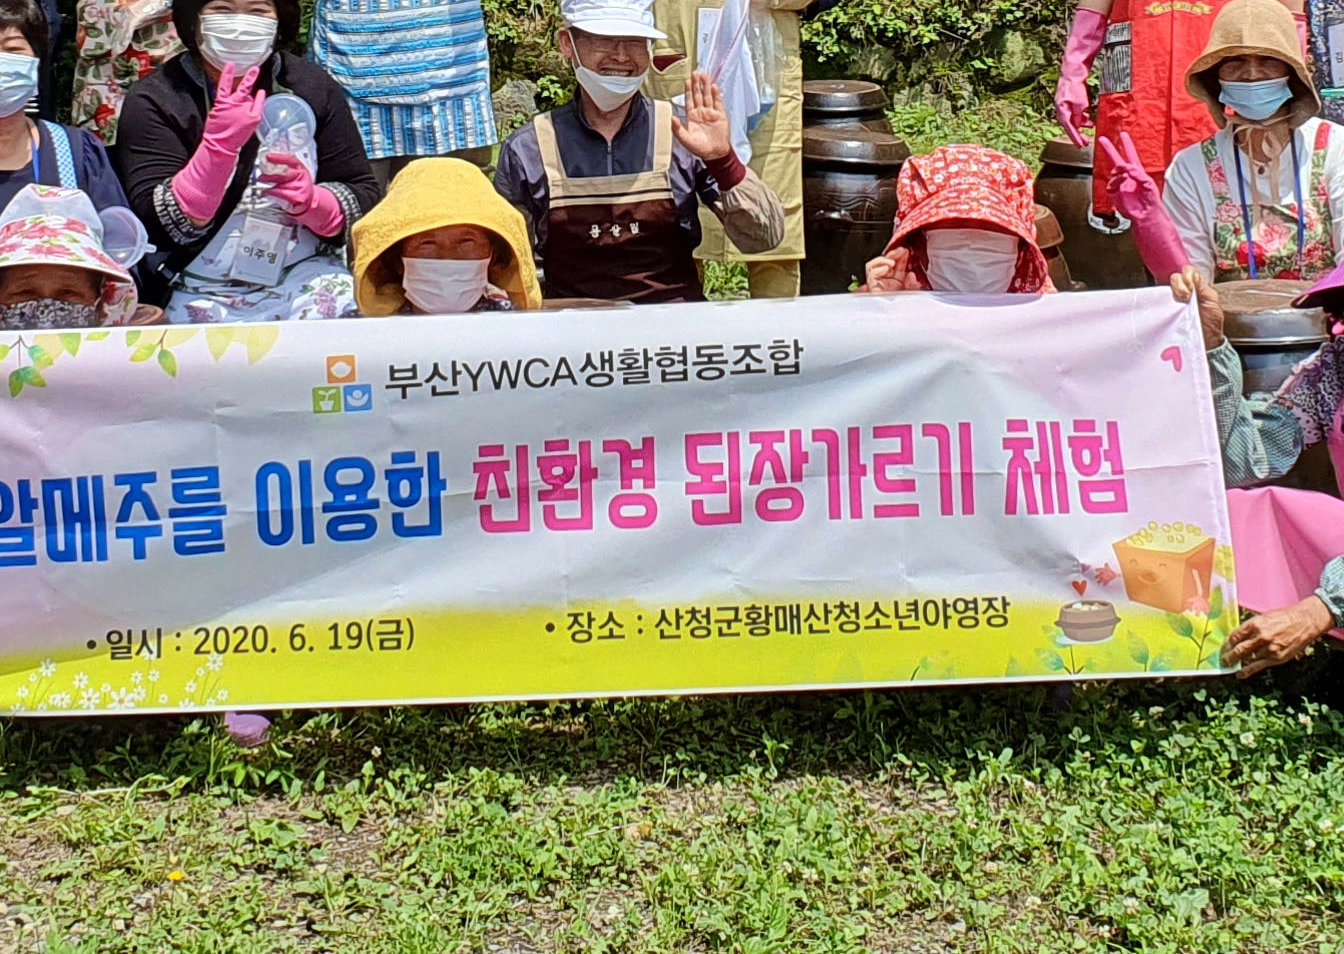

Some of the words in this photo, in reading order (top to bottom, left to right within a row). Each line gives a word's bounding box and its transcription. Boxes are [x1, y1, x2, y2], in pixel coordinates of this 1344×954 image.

[243, 246, 278, 265] 이주영
[385, 339, 804, 400] 부산YWCA생활협동조합
[255, 451, 448, 547] 이용한
[473, 436, 658, 533] 친환경
[685, 422, 975, 526] 된장가르기
[1003, 419, 1129, 516] 체험
[105, 628, 163, 661] 일시
[194, 625, 276, 655] 2020.
[289, 623, 316, 652] 6.
[328, 618, 415, 652] 19(금)
[567, 611, 626, 643] 장소
[654, 596, 1011, 641] 산청군황매산청소년야영장
